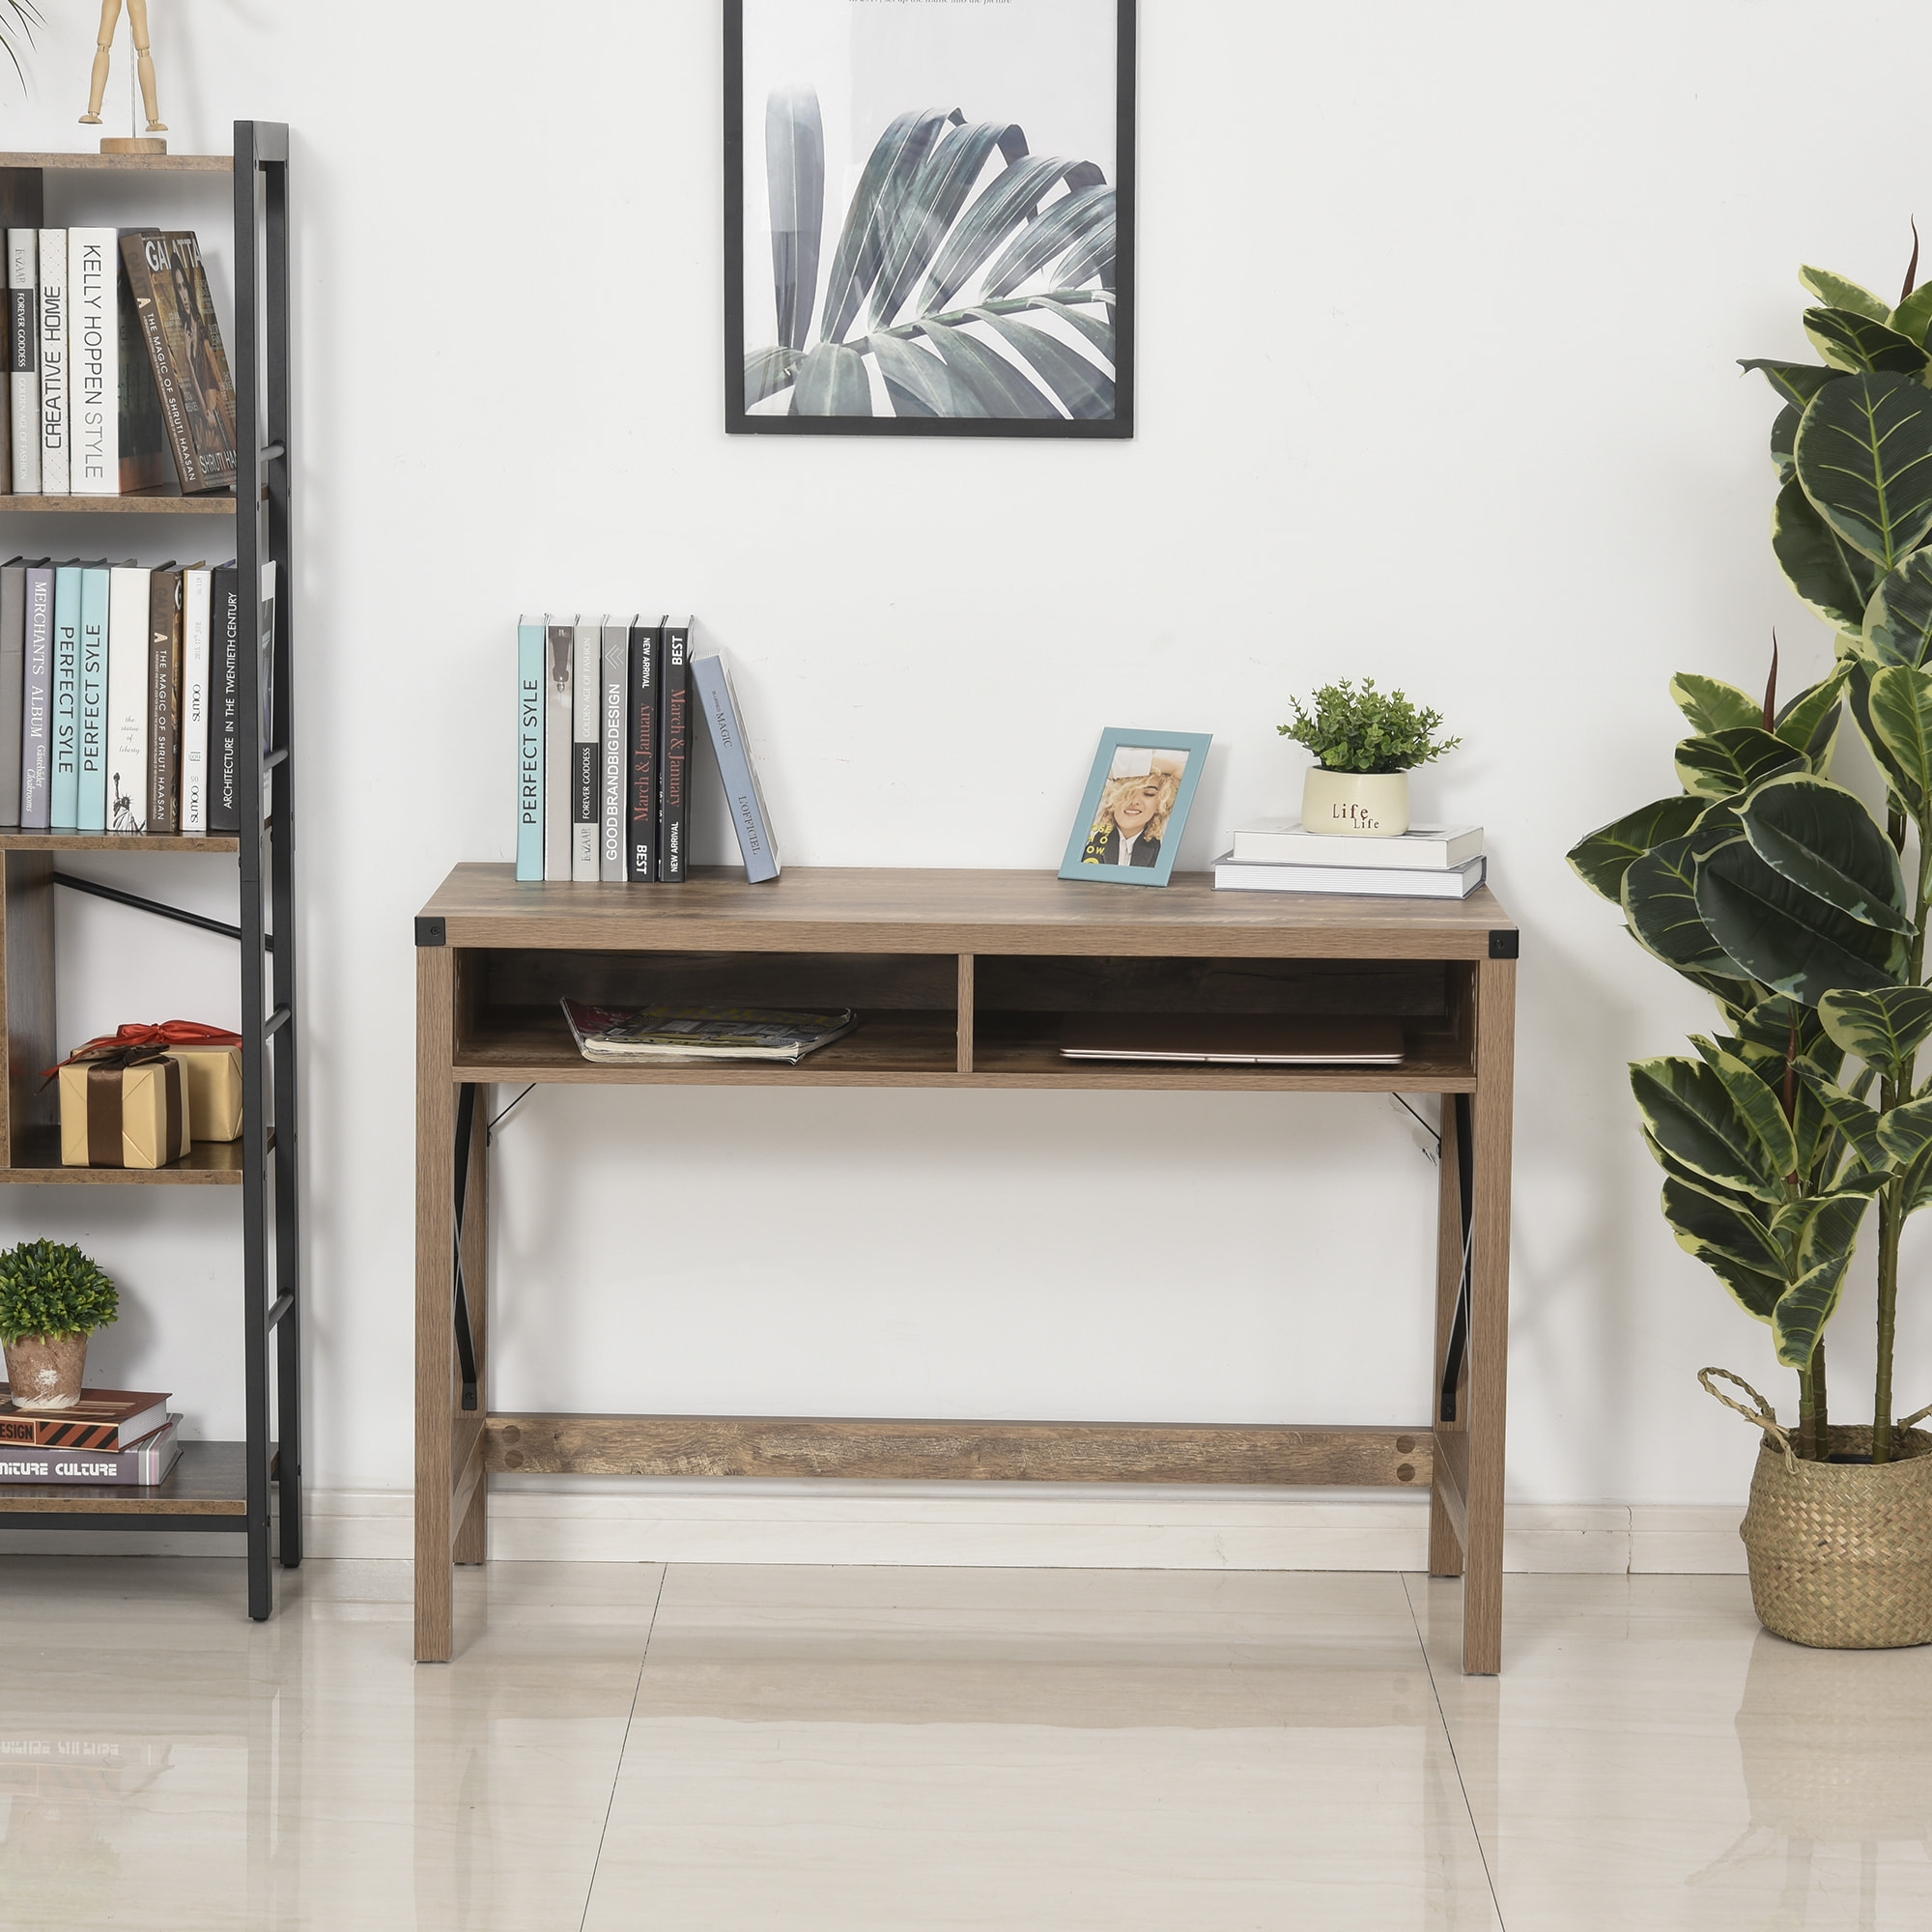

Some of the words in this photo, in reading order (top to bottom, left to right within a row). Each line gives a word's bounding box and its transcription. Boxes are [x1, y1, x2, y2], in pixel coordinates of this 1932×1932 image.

[83, 244, 101, 309] KELLY
[44, 286, 61, 341] HOME
[17, 331, 26, 367] GODDESS
[84, 317, 102, 404] HOPPEN
[44, 351, 62, 449] CREATIVE
[147, 313, 157, 332] THE
[153, 336, 168, 375] MAGIC
[164, 379, 174, 394] OF
[169, 397, 184, 434] SHRUTI
[179, 437, 195, 481] HAASAN
[85, 412, 103, 478] STYLE
[199, 452, 226, 474] SHRUTI
[32, 582, 47, 675] MERCHANTS
[227, 592, 238, 639] CENTURY
[86, 624, 100, 673] SYLE
[226, 641, 236, 695] TWENTIETH
[582, 638, 591, 670] FASHION
[671, 636, 683, 666] BEST
[58, 626, 74, 719] PERFECT
[582, 671, 590, 682] OF
[641, 658, 650, 689] ARRIVAL
[30, 686, 44, 738] ALBUM
[158, 716, 166, 731] OF
[225, 698, 235, 717] THE
[225, 720, 234, 731] IN
[523, 679, 538, 727] SYLE
[609, 684, 620, 738] DESIGN
[671, 690, 686, 732] March
[84, 680, 99, 772] PERFECT
[636, 703, 654, 757] January
[671, 739, 685, 750] &
[716, 713, 732, 749] MAGIC
[58, 725, 73, 773] SYLE
[635, 759, 648, 771] &
[24, 768, 36, 812] Cloakrooms
[222, 737, 234, 810] ARCHITECTURE
[523, 734, 538, 824] PERFECT
[667, 753, 685, 808] January
[156, 776, 165, 820] HAASAN
[634, 779, 649, 822] March
[1333, 803, 1369, 819] Life
[606, 816, 618, 861] GOOD
[670, 821, 679, 850] ARRIVAL
[738, 796, 761, 855] L'OFFICIEL
[1353, 818, 1379, 829] Life
[636, 844, 647, 874] BEST
[0, 1423, 33, 1439] ESIGN
